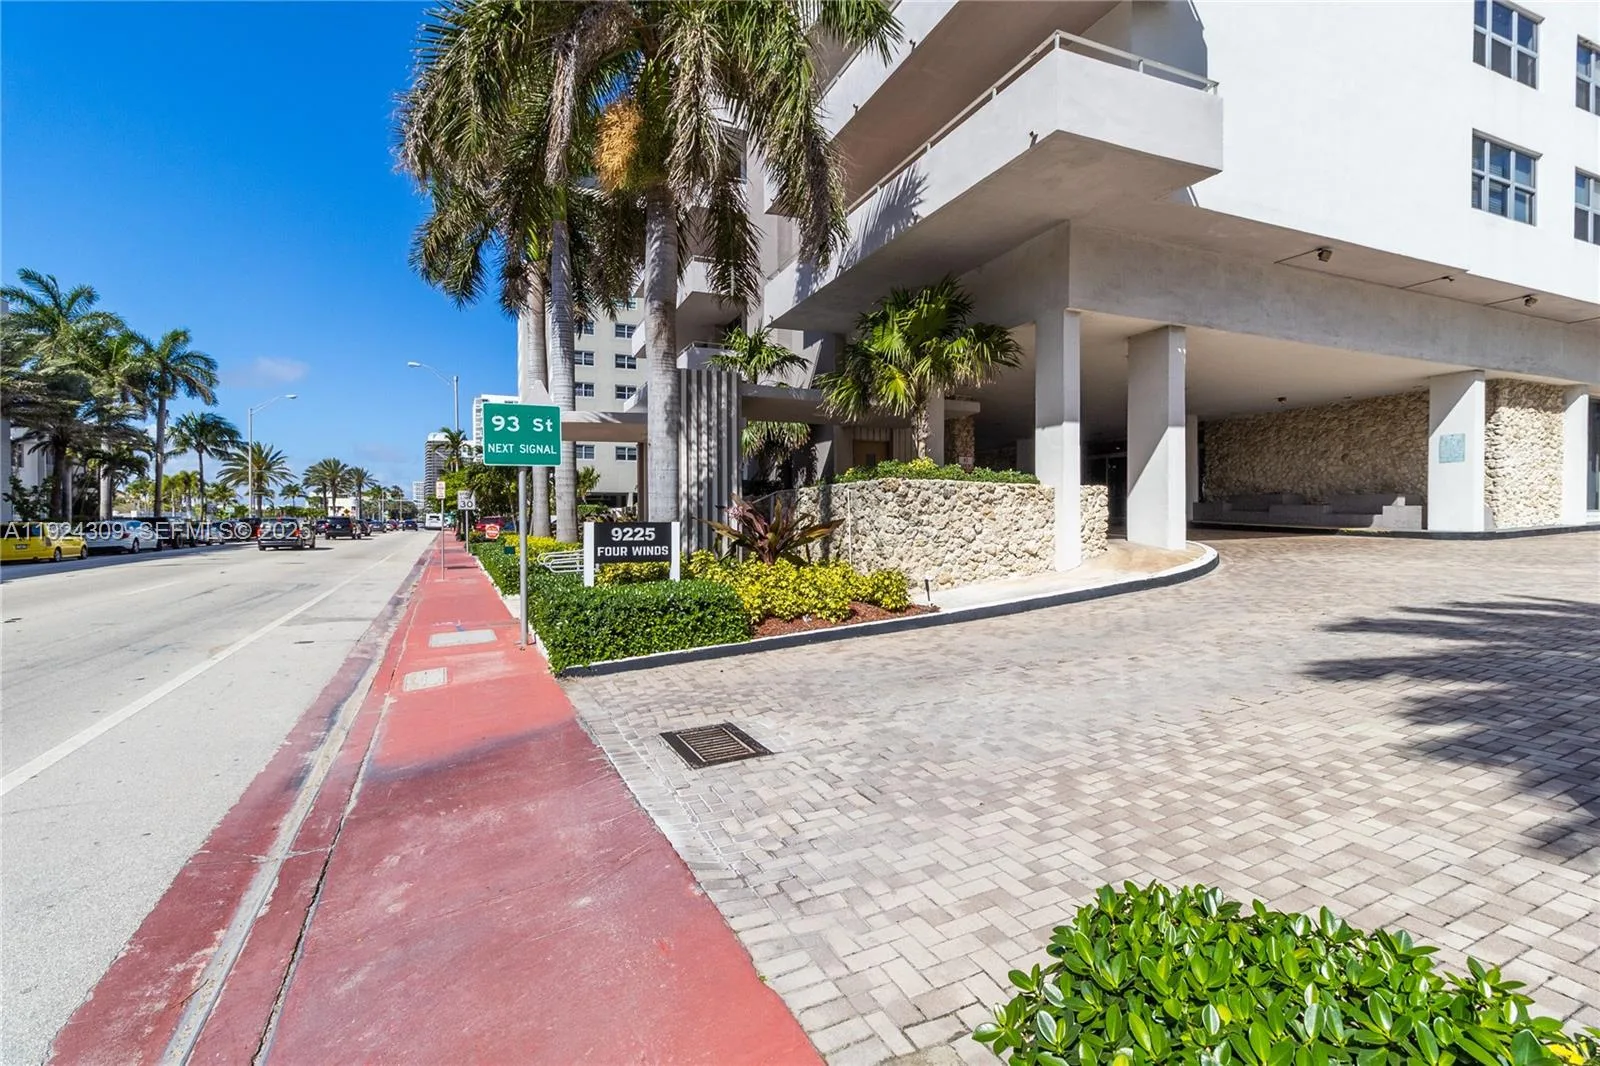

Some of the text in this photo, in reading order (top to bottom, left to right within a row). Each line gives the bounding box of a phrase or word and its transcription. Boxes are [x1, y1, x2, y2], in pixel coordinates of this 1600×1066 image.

[491, 415, 553, 432] 93 St
[487, 443, 557, 455] NEXT SIGNAL
[460, 500, 474, 508] 30
[611, 527, 656, 542] 9225
[597, 545, 669, 557] FOUR WINDS
